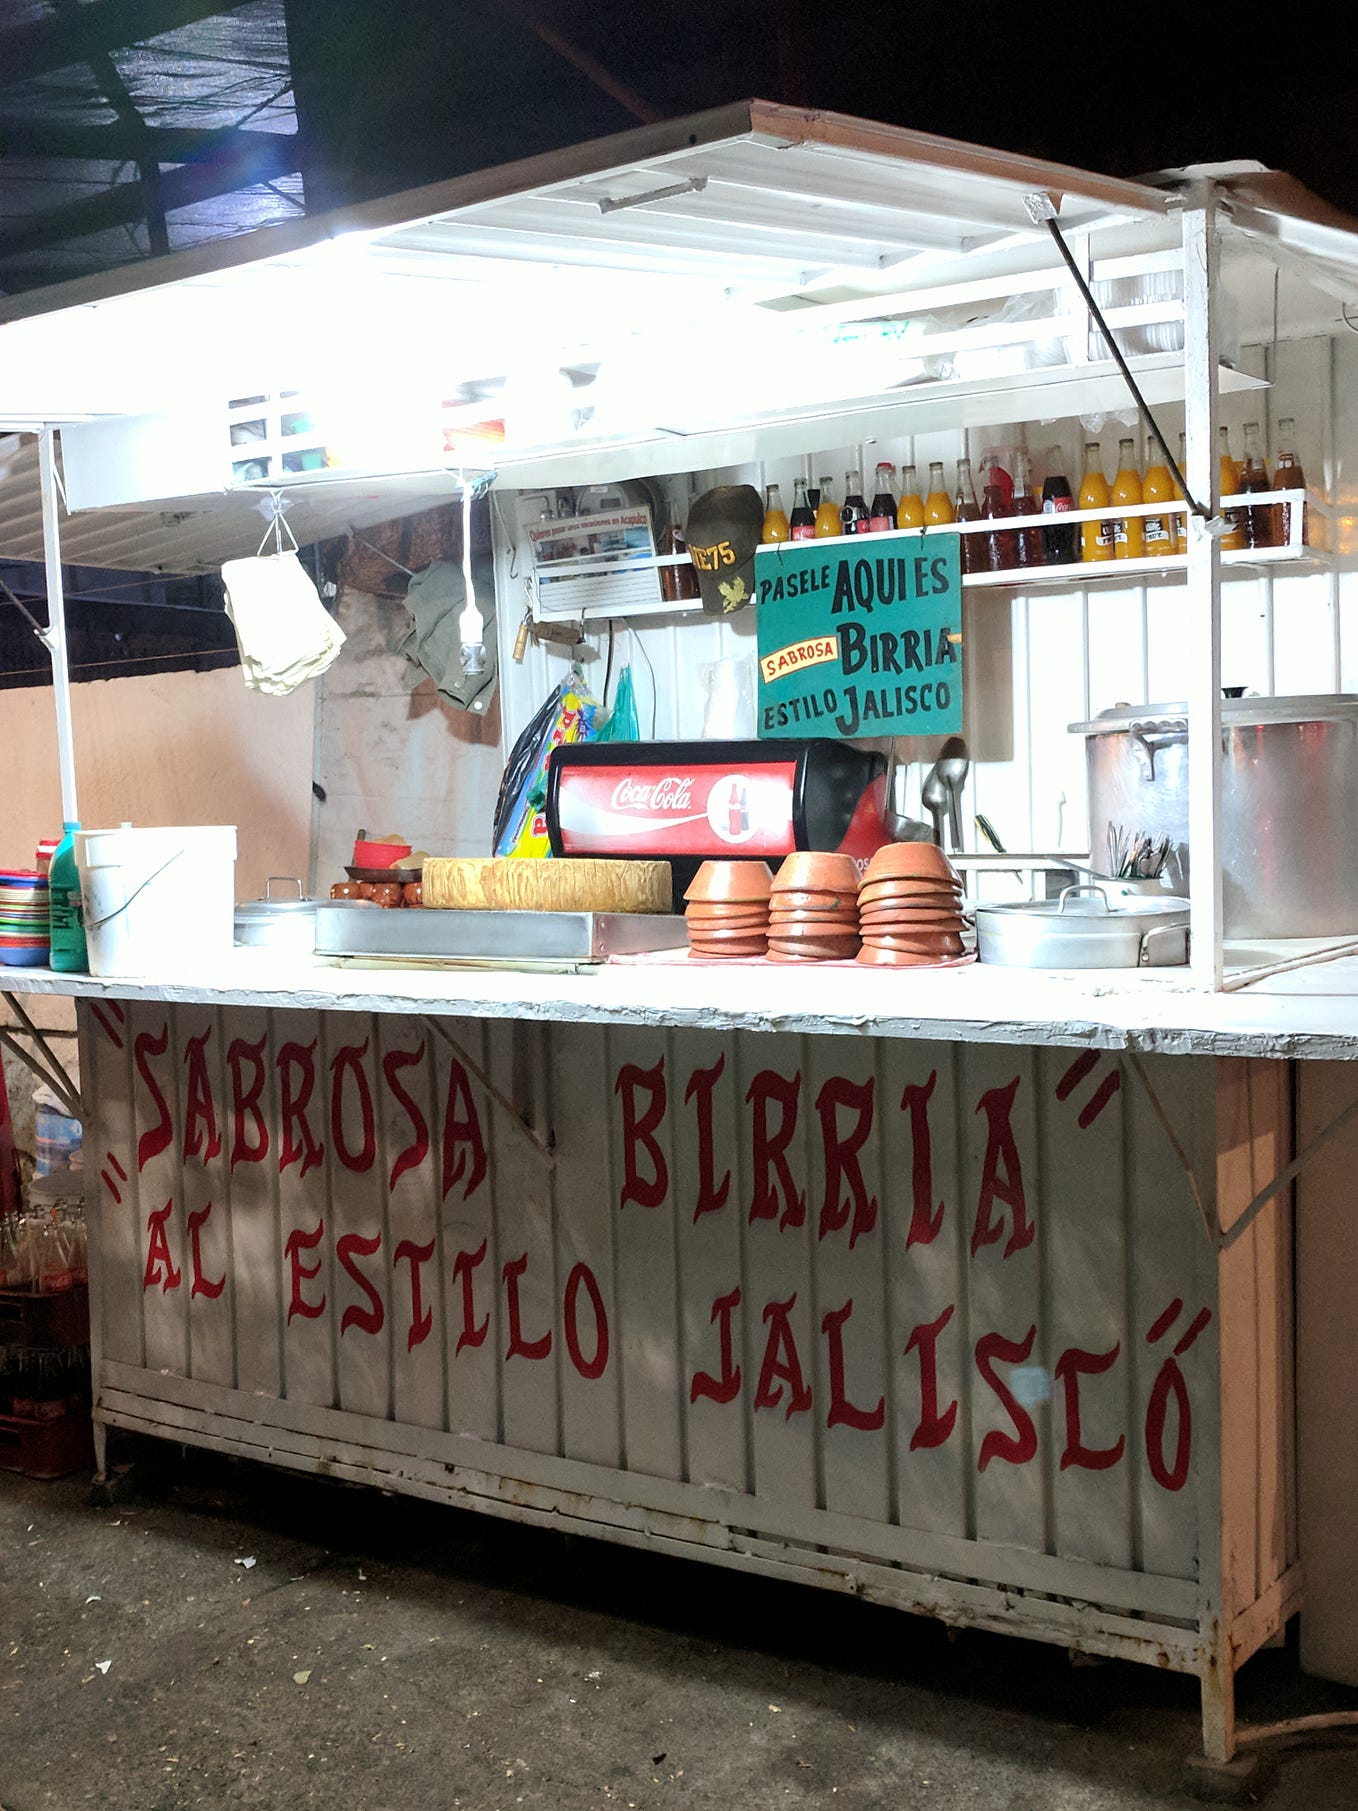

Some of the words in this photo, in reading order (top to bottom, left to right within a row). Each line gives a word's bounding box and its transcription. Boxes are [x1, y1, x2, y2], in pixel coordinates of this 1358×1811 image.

[620, 512, 648, 527] Acapulco
[759, 565, 830, 605] PASELE
[831, 558, 906, 614] AQUI
[914, 557, 949, 598] ES
[766, 641, 834, 677] SABROSA
[836, 622, 957, 676] BIRRIA
[764, 688, 838, 730] ESTILO
[835, 681, 950, 736] JALISCO
[611, 777, 696, 810] Coca-Cola
[285, 1218, 609, 1380] ESTILO
